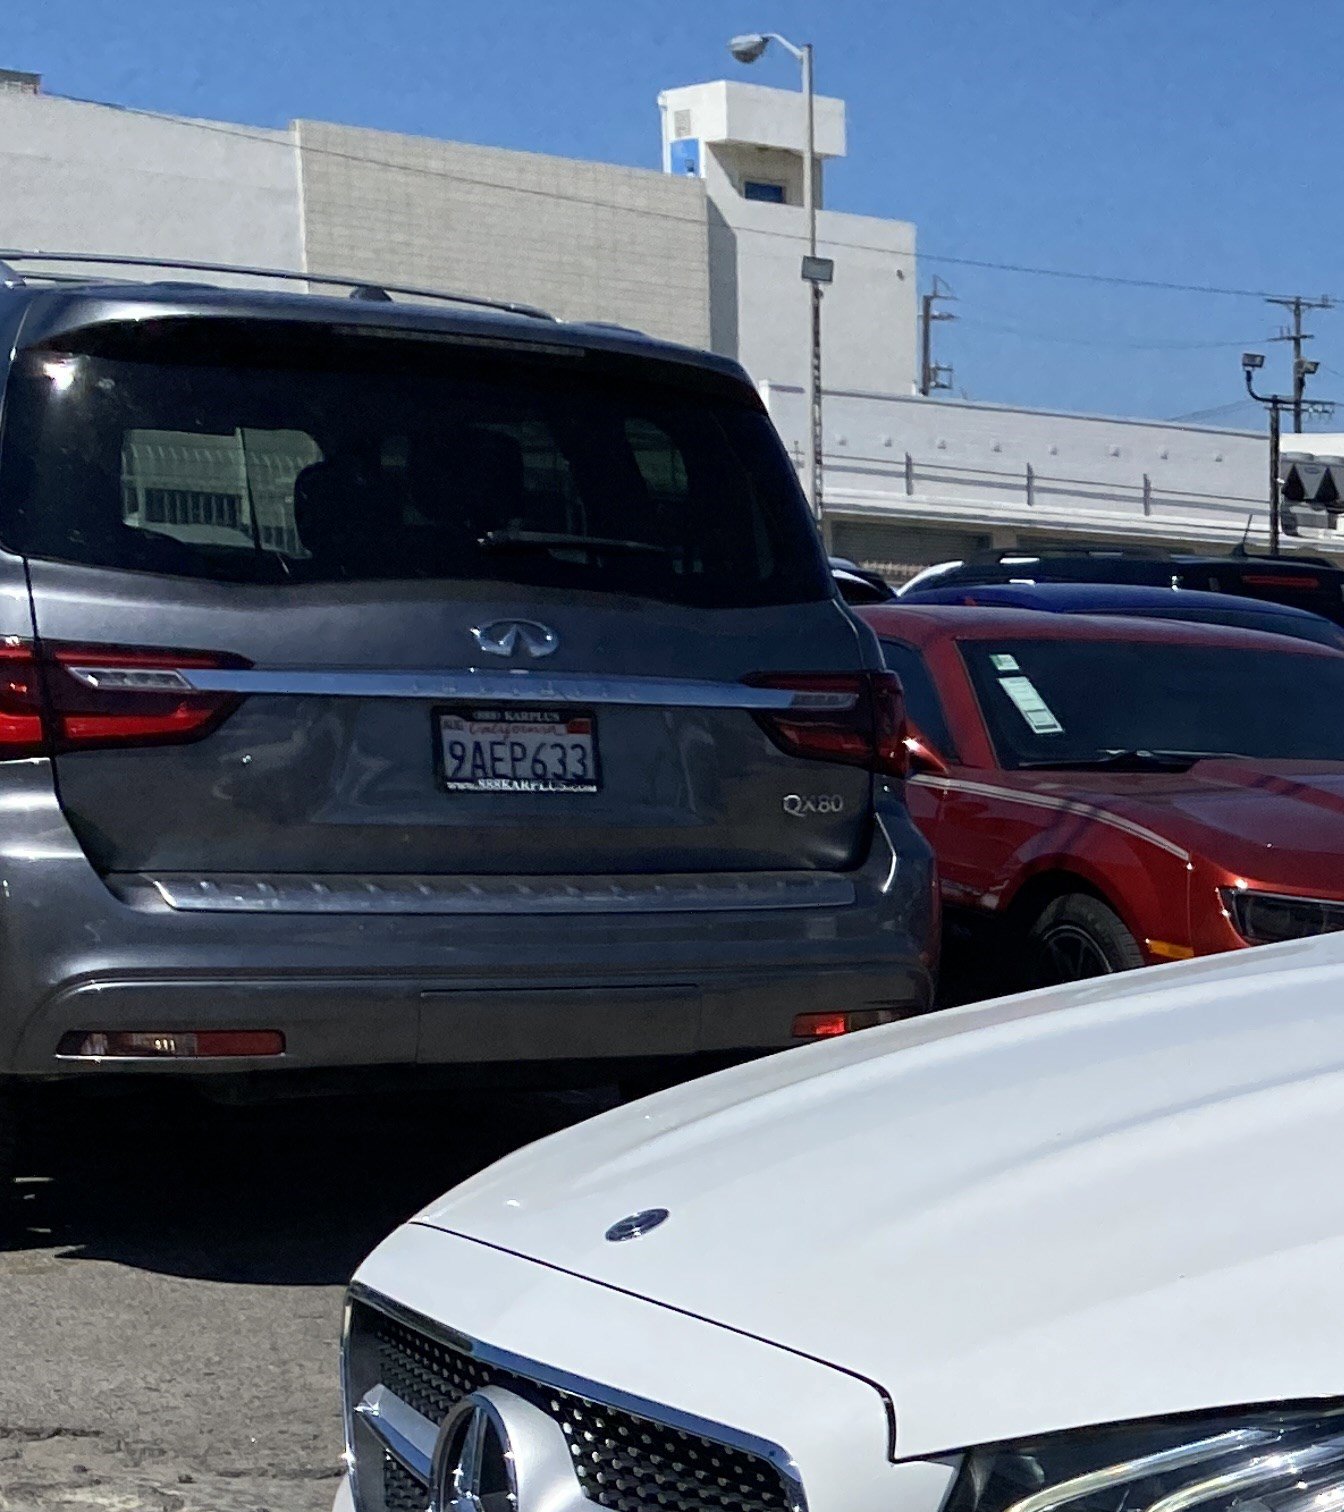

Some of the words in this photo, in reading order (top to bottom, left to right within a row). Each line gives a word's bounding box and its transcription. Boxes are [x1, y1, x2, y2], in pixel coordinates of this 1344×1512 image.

[504, 711, 559, 721] KARPLUS
[449, 740, 587, 780] 9AEP633
[783, 794, 843, 818] QX80
